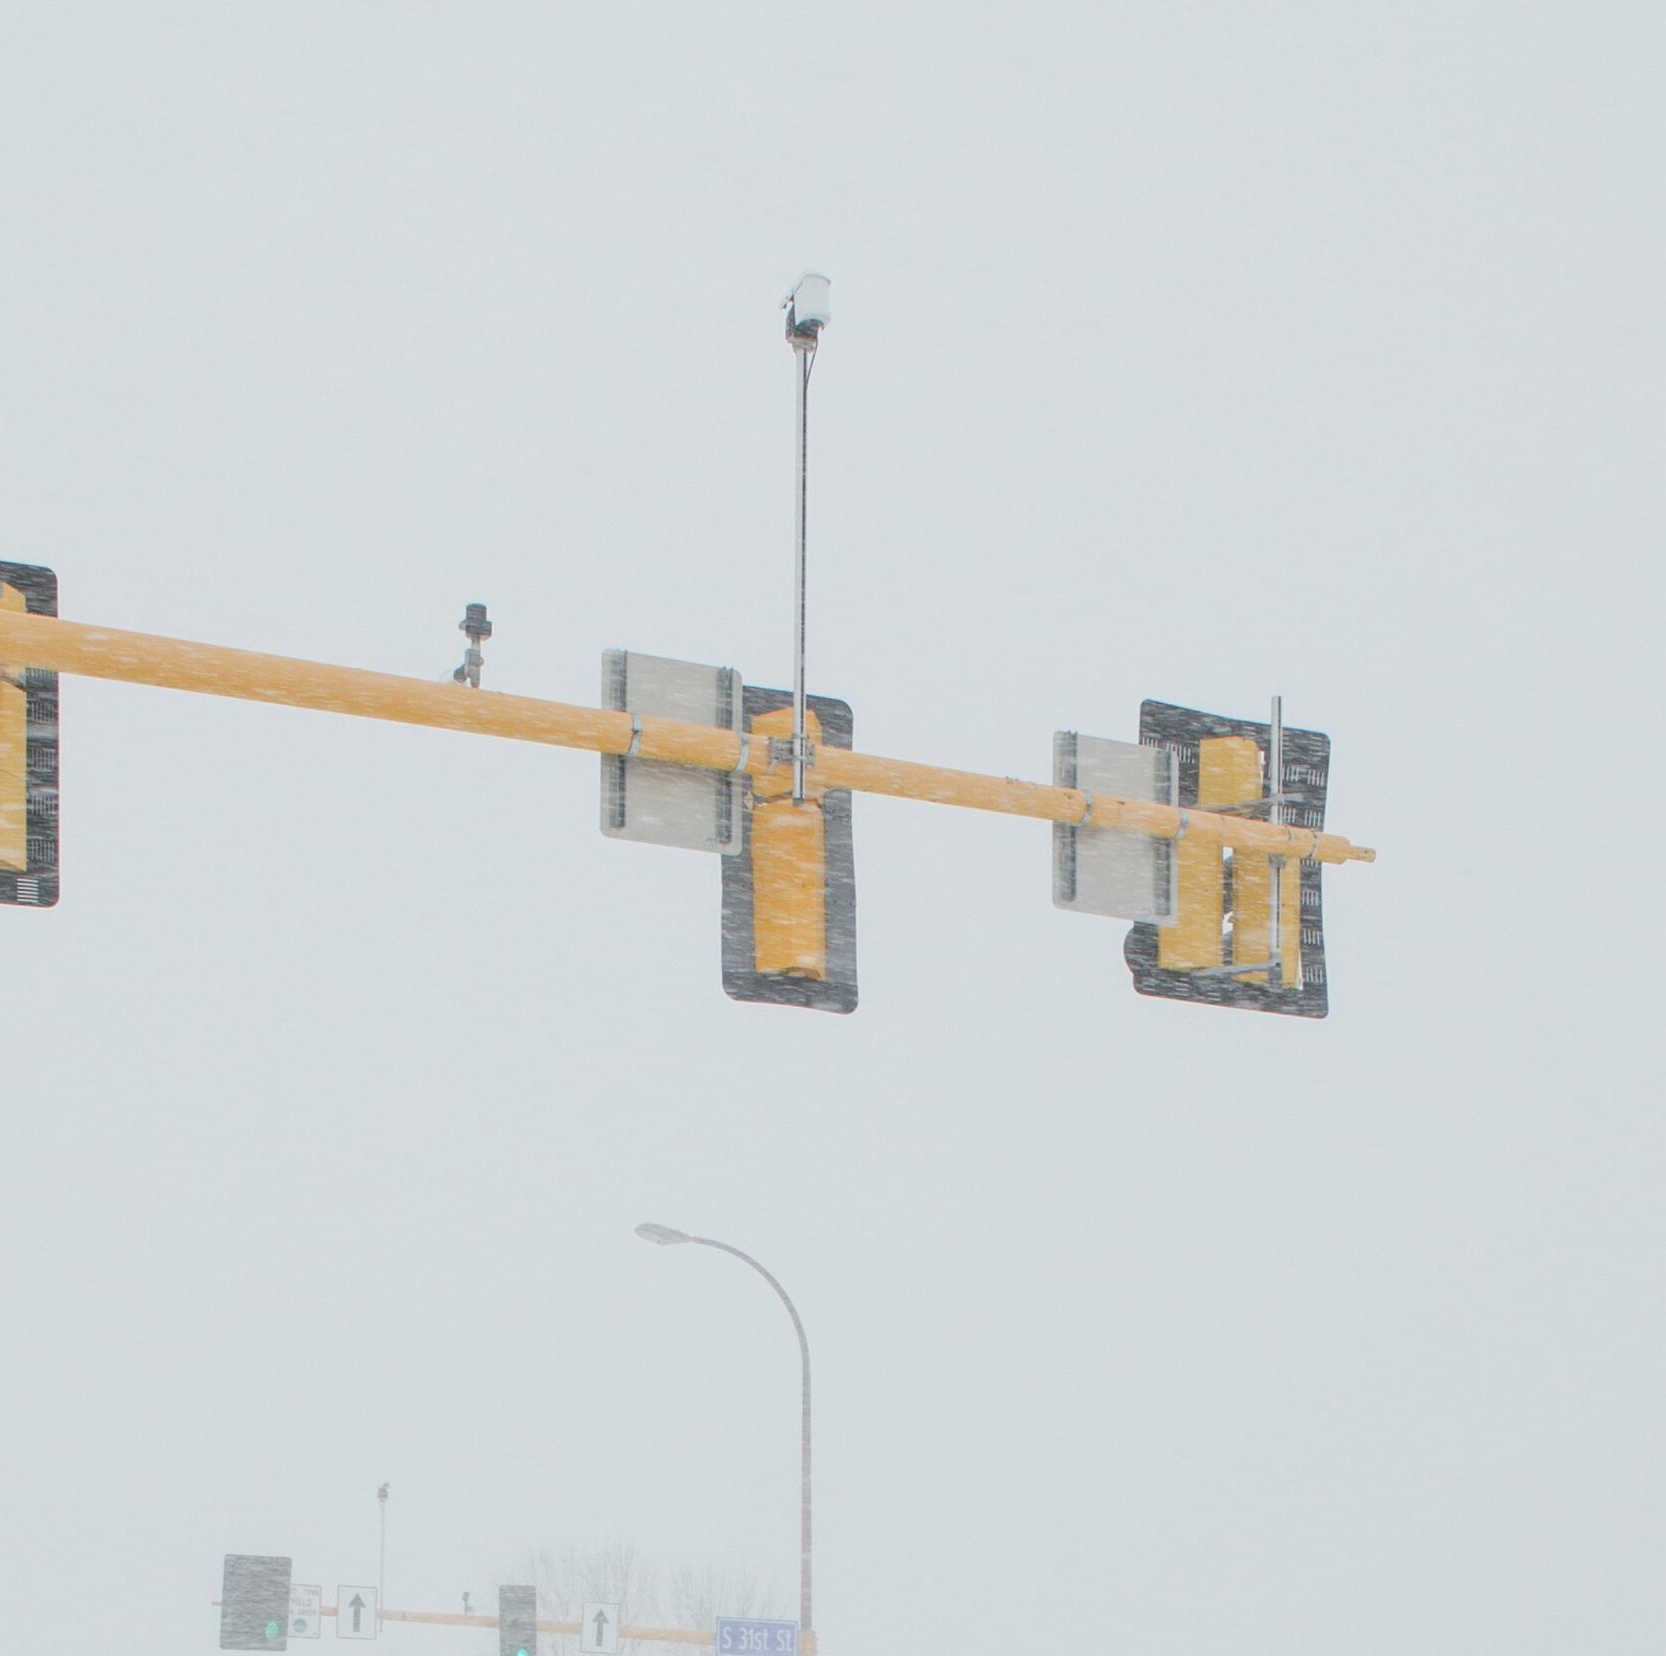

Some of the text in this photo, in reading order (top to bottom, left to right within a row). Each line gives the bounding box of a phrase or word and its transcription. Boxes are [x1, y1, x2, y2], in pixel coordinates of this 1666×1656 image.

[290, 1596, 313, 1607] YIELD
[722, 1626, 793, 1652] S 31st St
